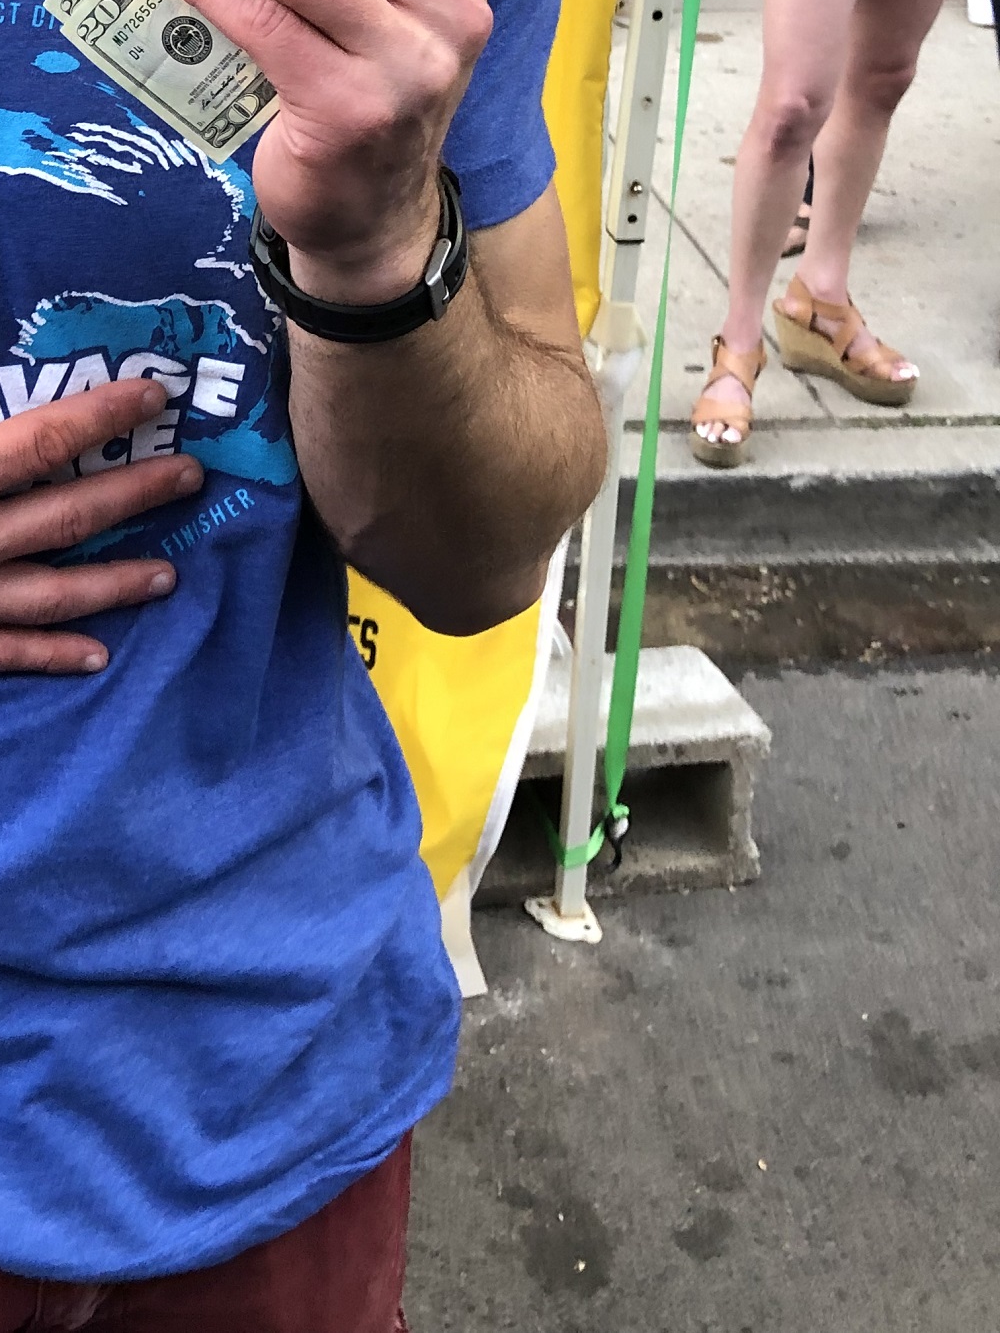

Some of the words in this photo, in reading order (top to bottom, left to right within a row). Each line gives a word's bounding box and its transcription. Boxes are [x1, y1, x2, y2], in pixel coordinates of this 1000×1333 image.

[128, 46, 146, 62] D4
[200, 92, 262, 150] 20
[160, 487, 256, 558] FINISHER
